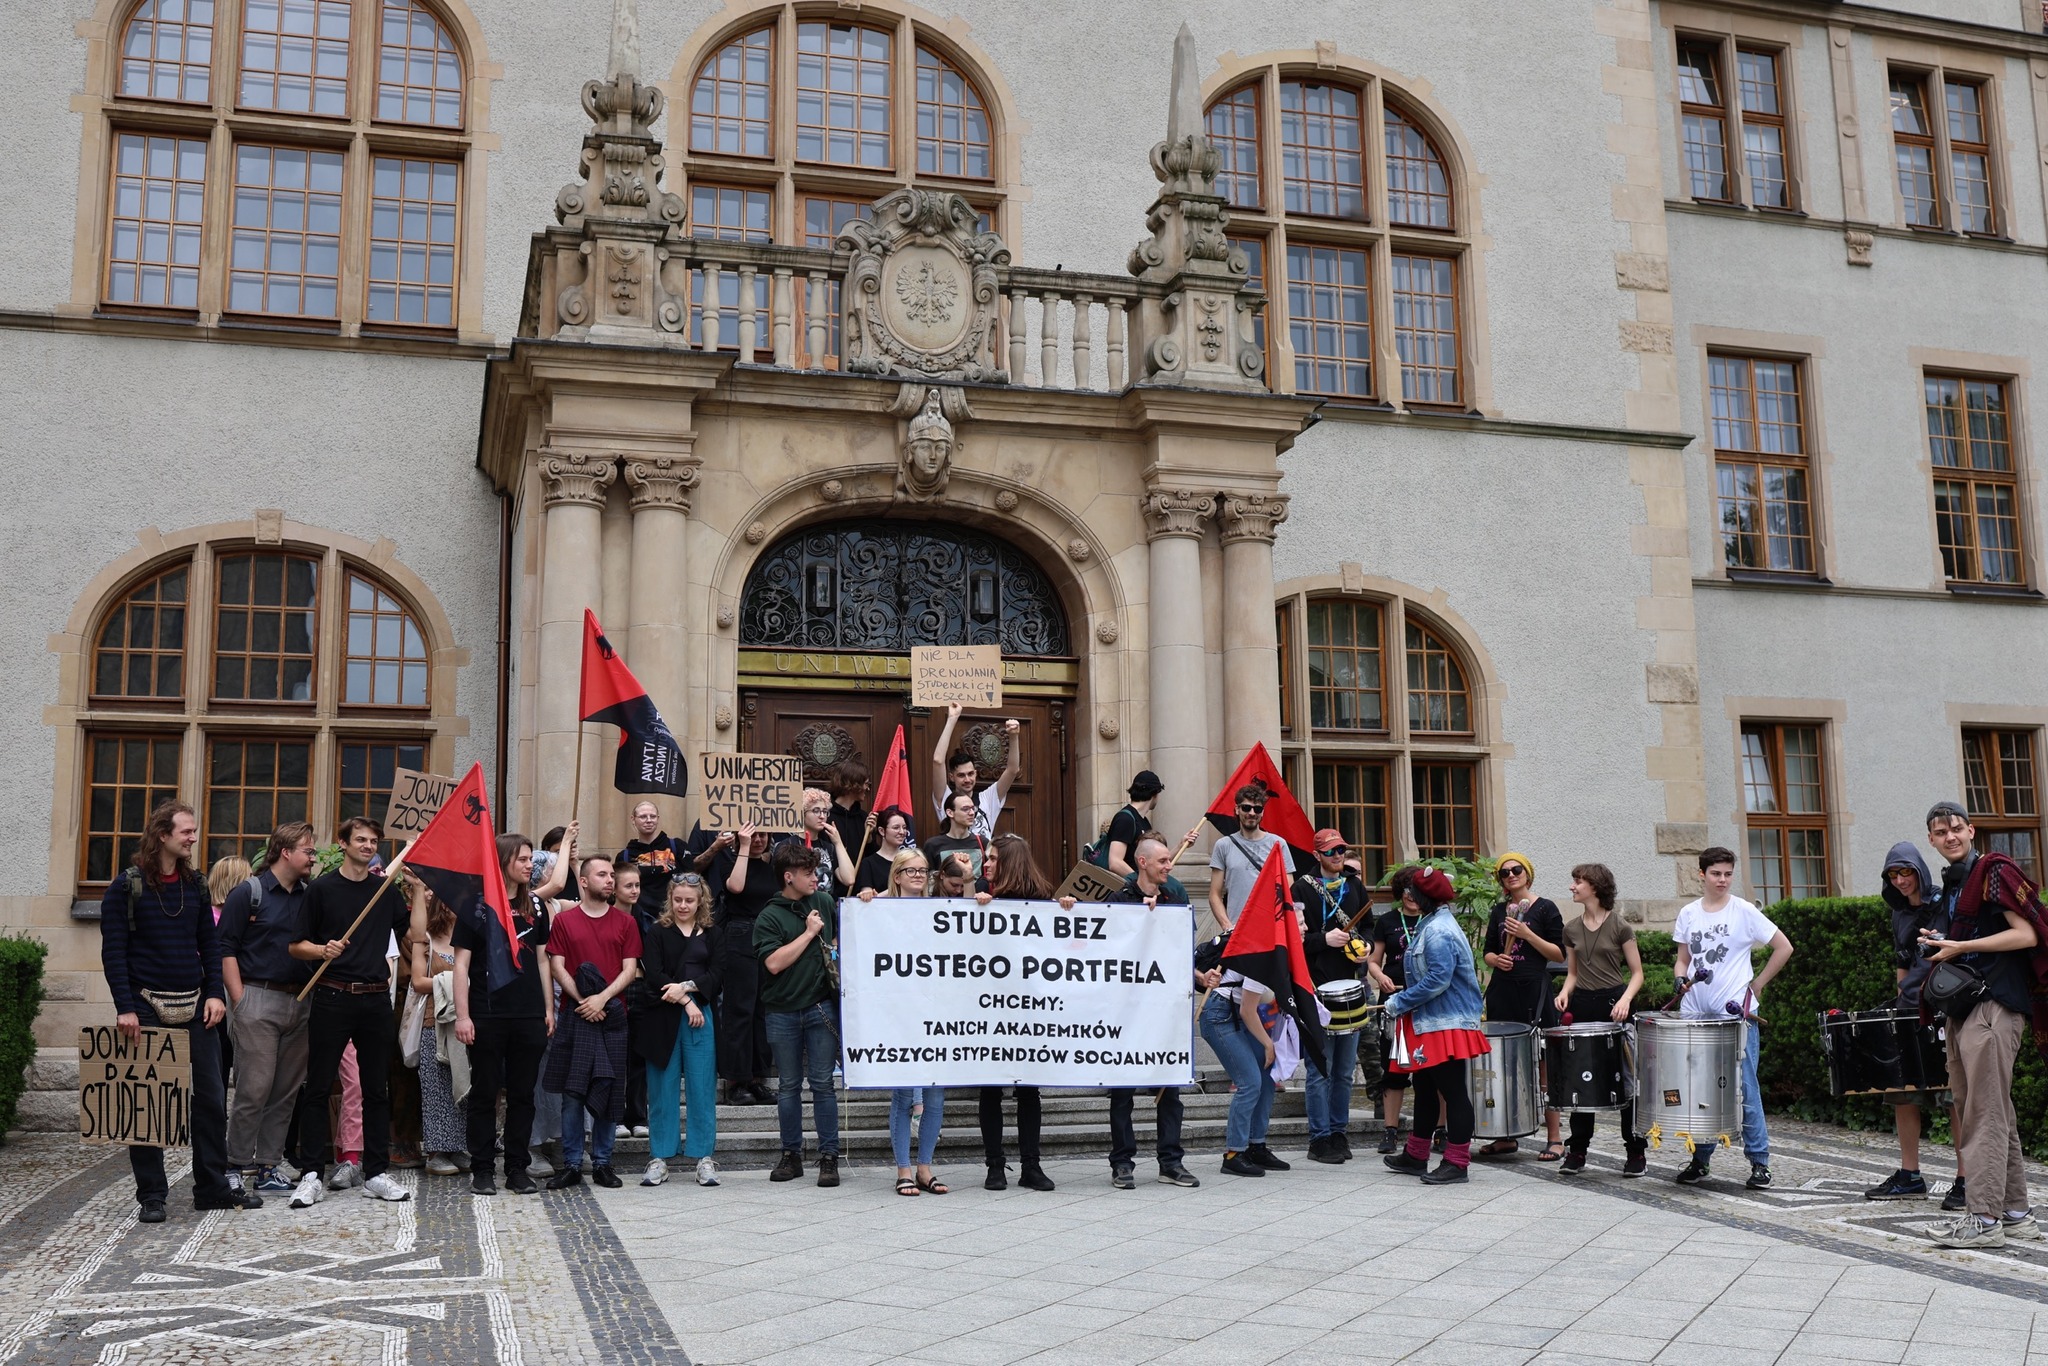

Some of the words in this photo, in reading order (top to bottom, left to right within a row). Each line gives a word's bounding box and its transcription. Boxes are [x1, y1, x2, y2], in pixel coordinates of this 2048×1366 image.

[948, 650, 975, 661] DLA
[400, 775, 458, 808] JOWIT
[708, 802, 804, 828] STUDENTÓW
[1072, 874, 1114, 902] STU
[933, 910, 1043, 938] STUDIA
[1053, 916, 1107, 940] BEZ
[874, 953, 1011, 979] PUSTEGO
[1022, 954, 1166, 984] PORTFELA
[978, 993, 1064, 1011] CHCEMY:
[923, 1020, 988, 1036] TANICH
[992, 1019, 1123, 1039] AKADEMIKÓW
[81, 1026, 176, 1062] JOWITA
[847, 1043, 947, 1063] WYŻSZYCH
[952, 1045, 1069, 1064] STYPENDIÓW
[1073, 1050, 1190, 1066] SOCJALNYCH
[105, 1063, 158, 1081] DLA
[82, 1077, 189, 1146] STUDENTÓW
